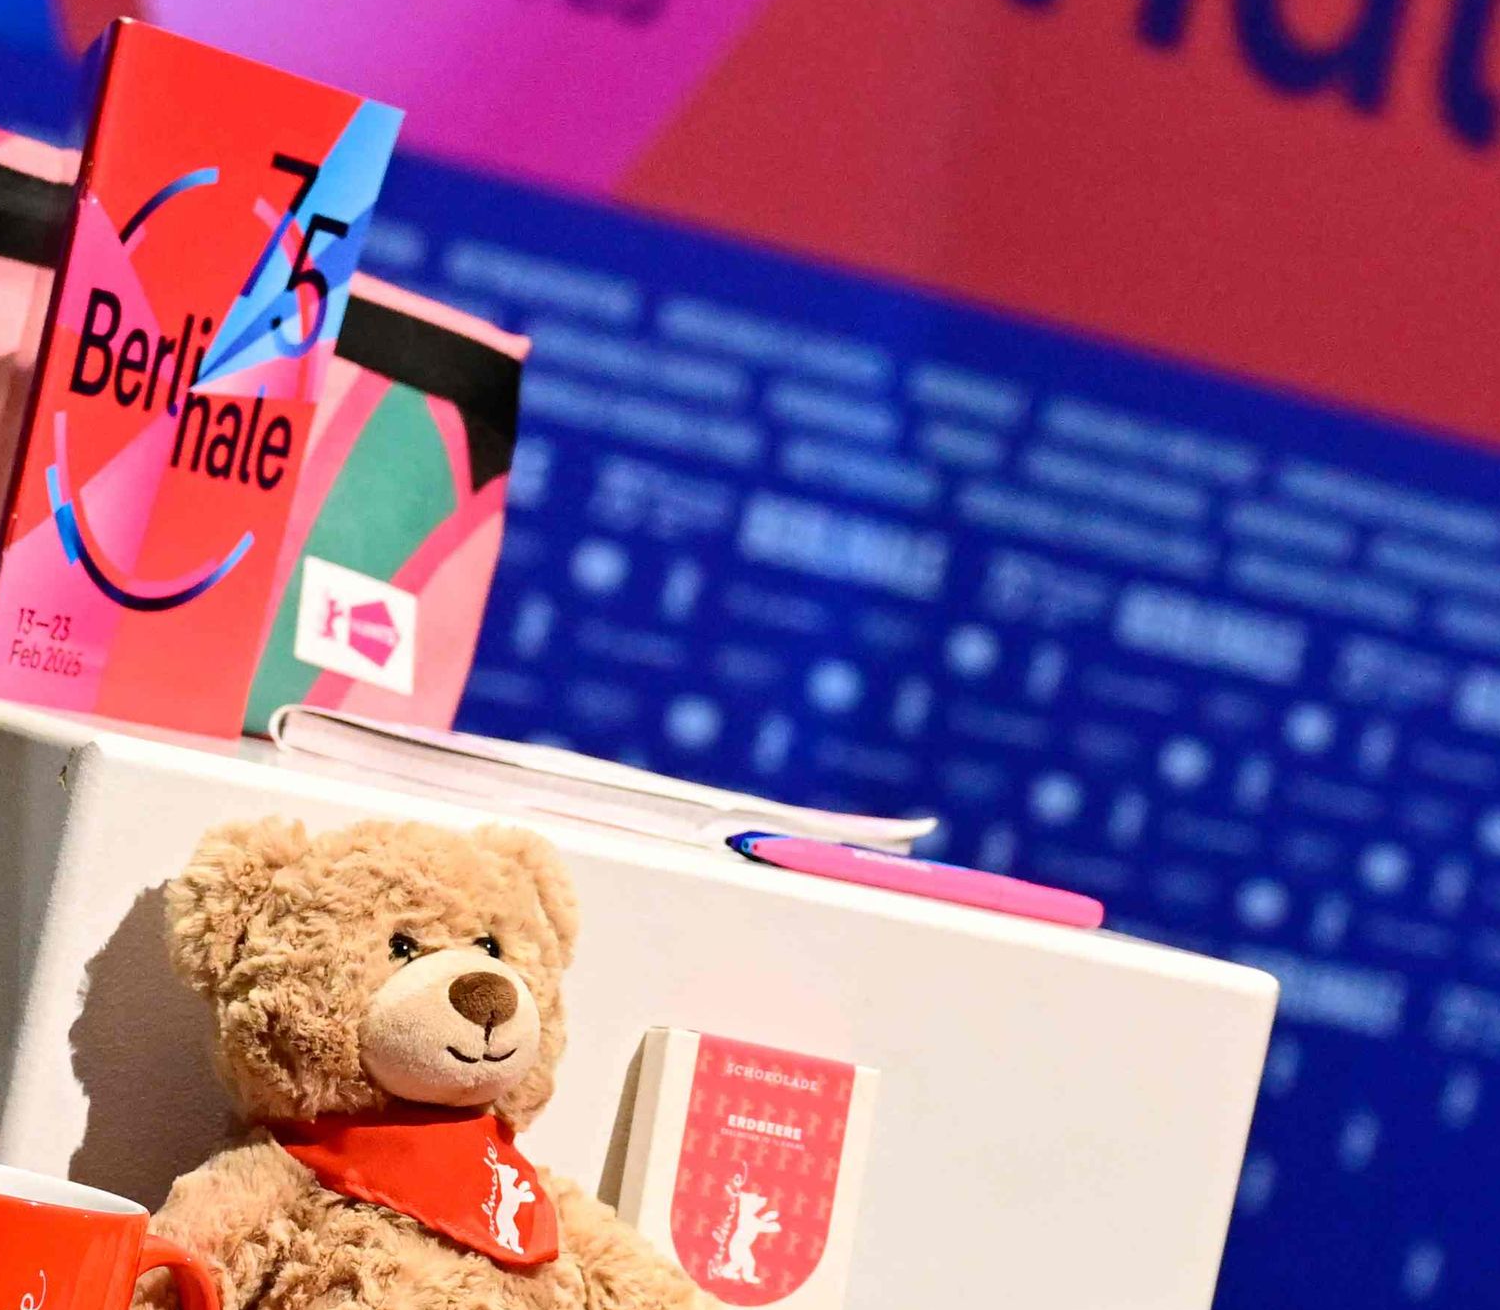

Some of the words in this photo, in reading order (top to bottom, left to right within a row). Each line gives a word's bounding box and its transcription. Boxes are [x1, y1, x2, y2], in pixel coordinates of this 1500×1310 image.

[240, 152, 350, 360] 75
[8, 638, 42, 670] Feb
[725, 1061, 819, 1092] SCHOKOLADE
[727, 1113, 803, 1141] ERDBEERE
